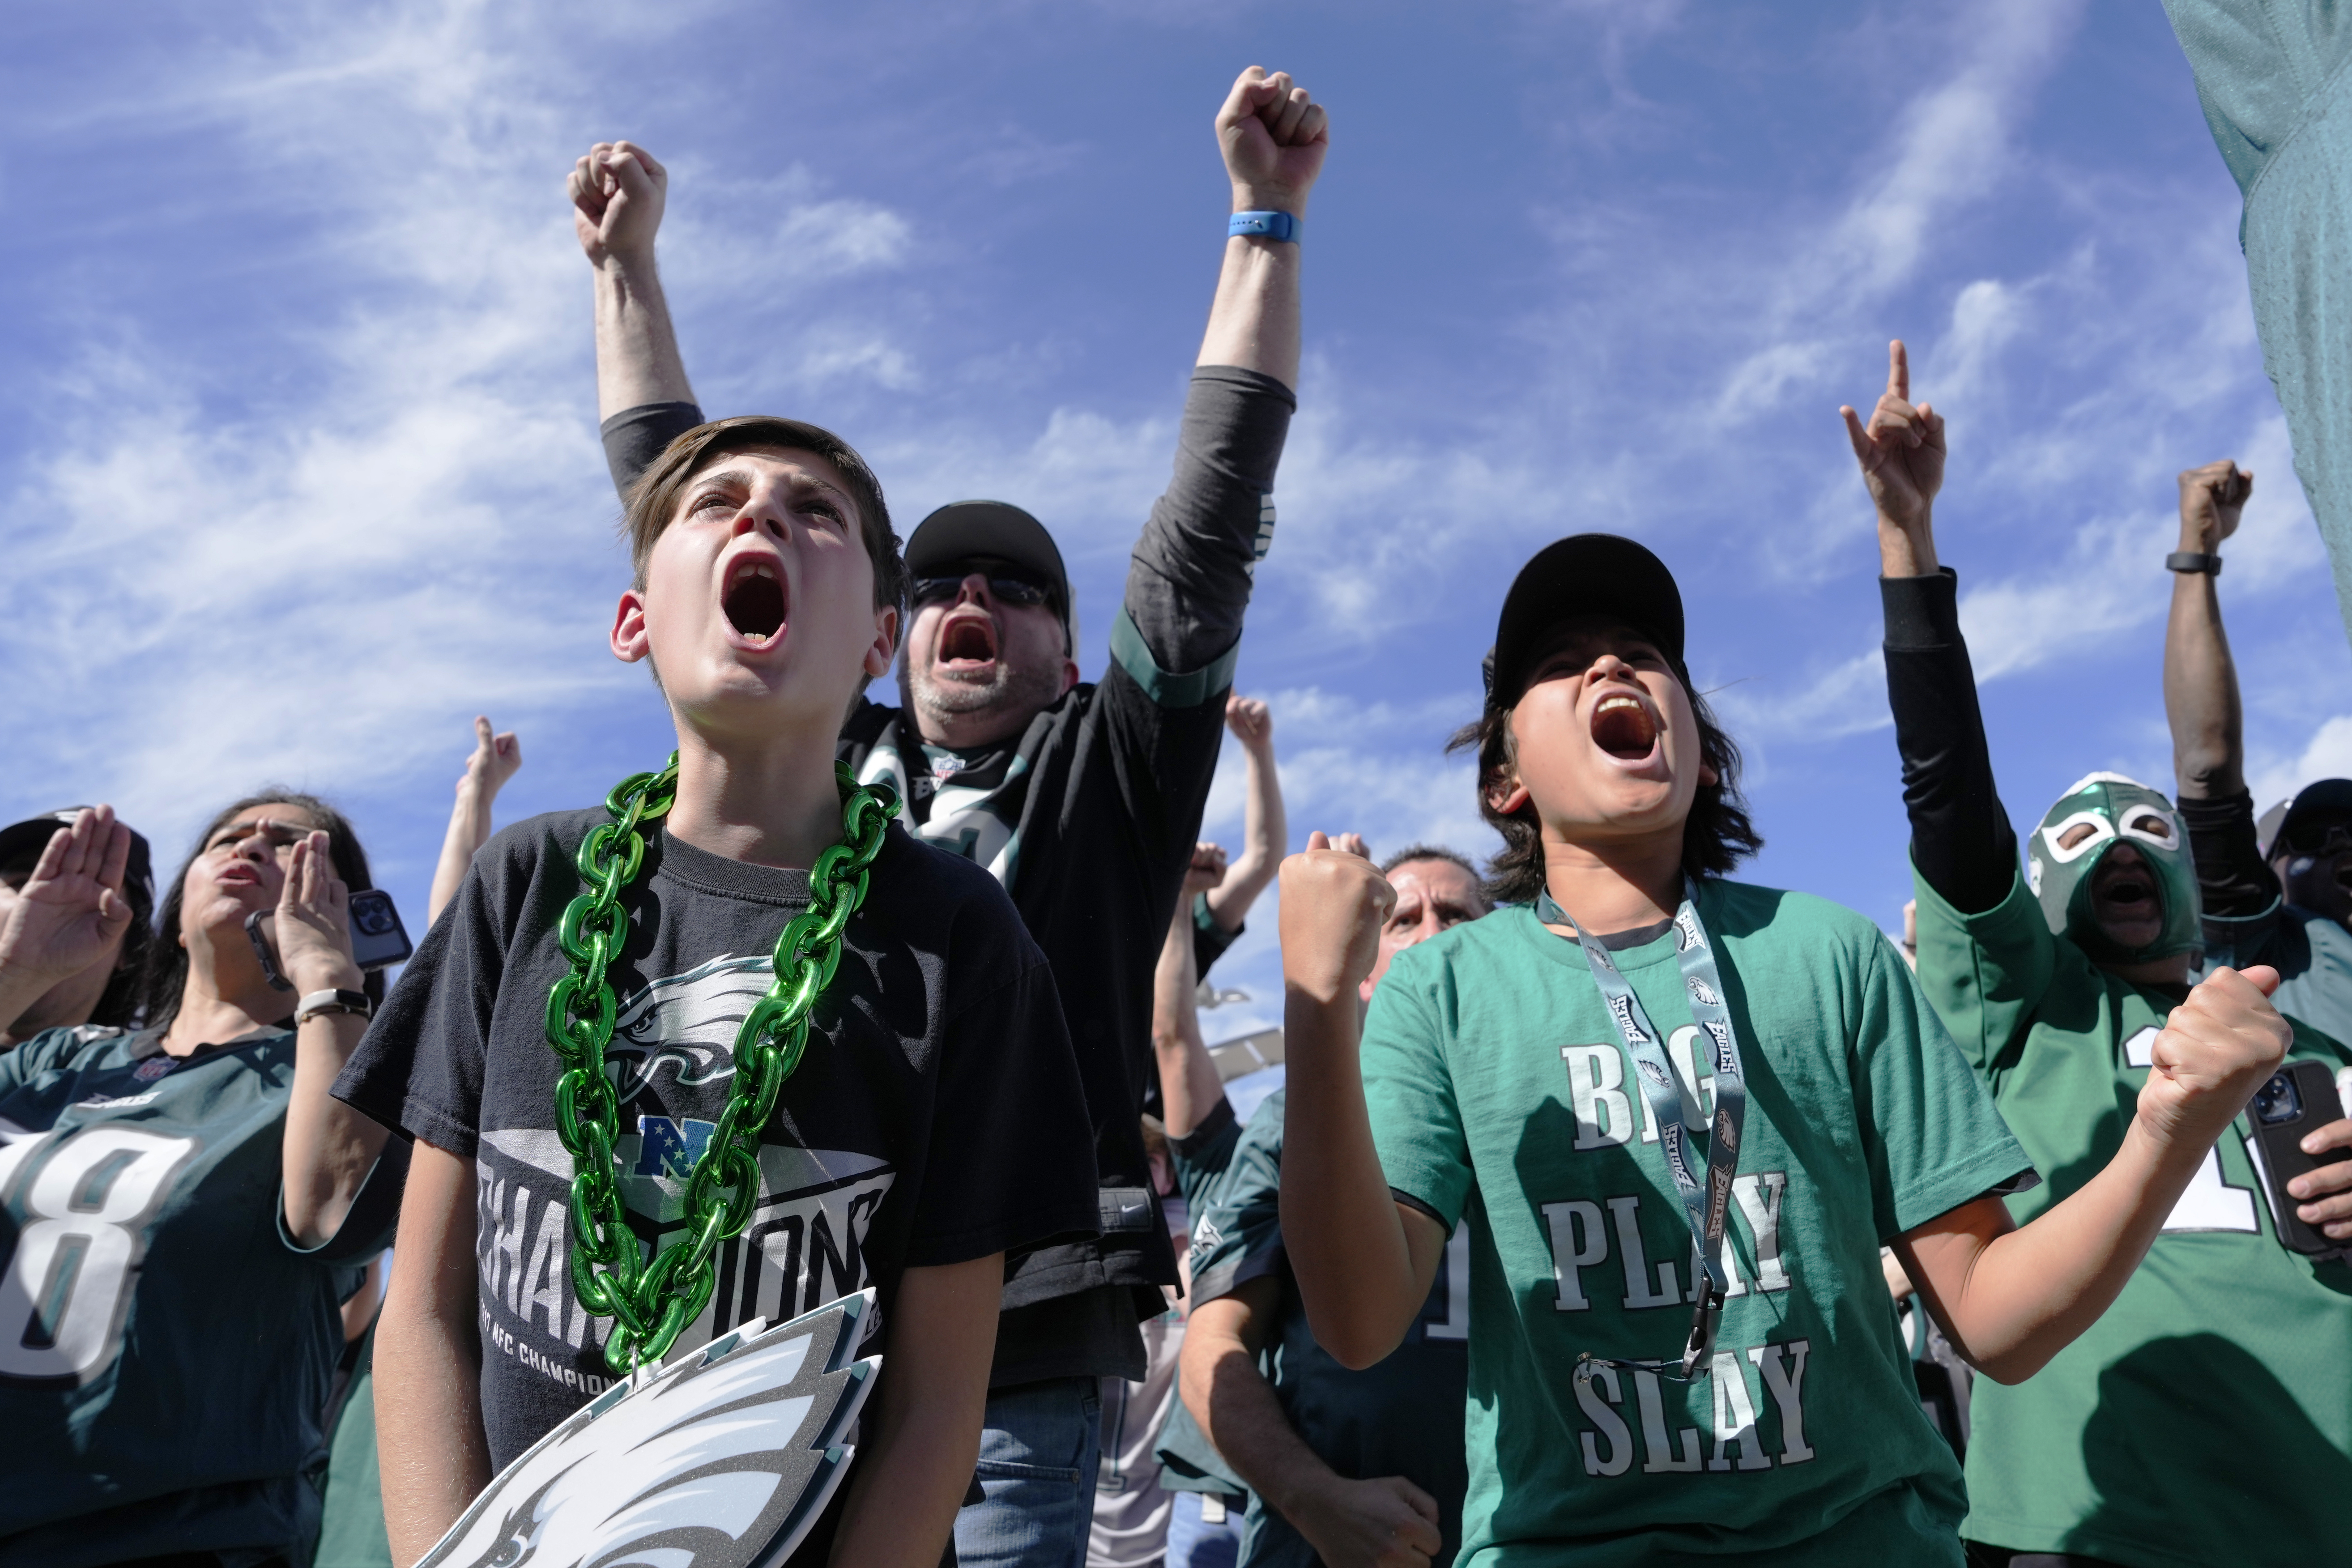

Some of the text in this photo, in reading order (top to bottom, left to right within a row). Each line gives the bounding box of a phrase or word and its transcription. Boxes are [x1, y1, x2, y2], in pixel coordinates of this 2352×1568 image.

[1675, 902, 1706, 953] EAGLES
[1606, 992, 1652, 1052] EAGLES
[1701, 1014, 1740, 1084] EAGLES
[1658, 1116, 1698, 1195] EAGLES
[1705, 1163, 1734, 1248] EAGLES
[0, 1116, 197, 1378] 8
[476, 1157, 888, 1349] CHAION
[492, 1321, 514, 1355] NFC
[1571, 1337, 1816, 1477] SLAY
